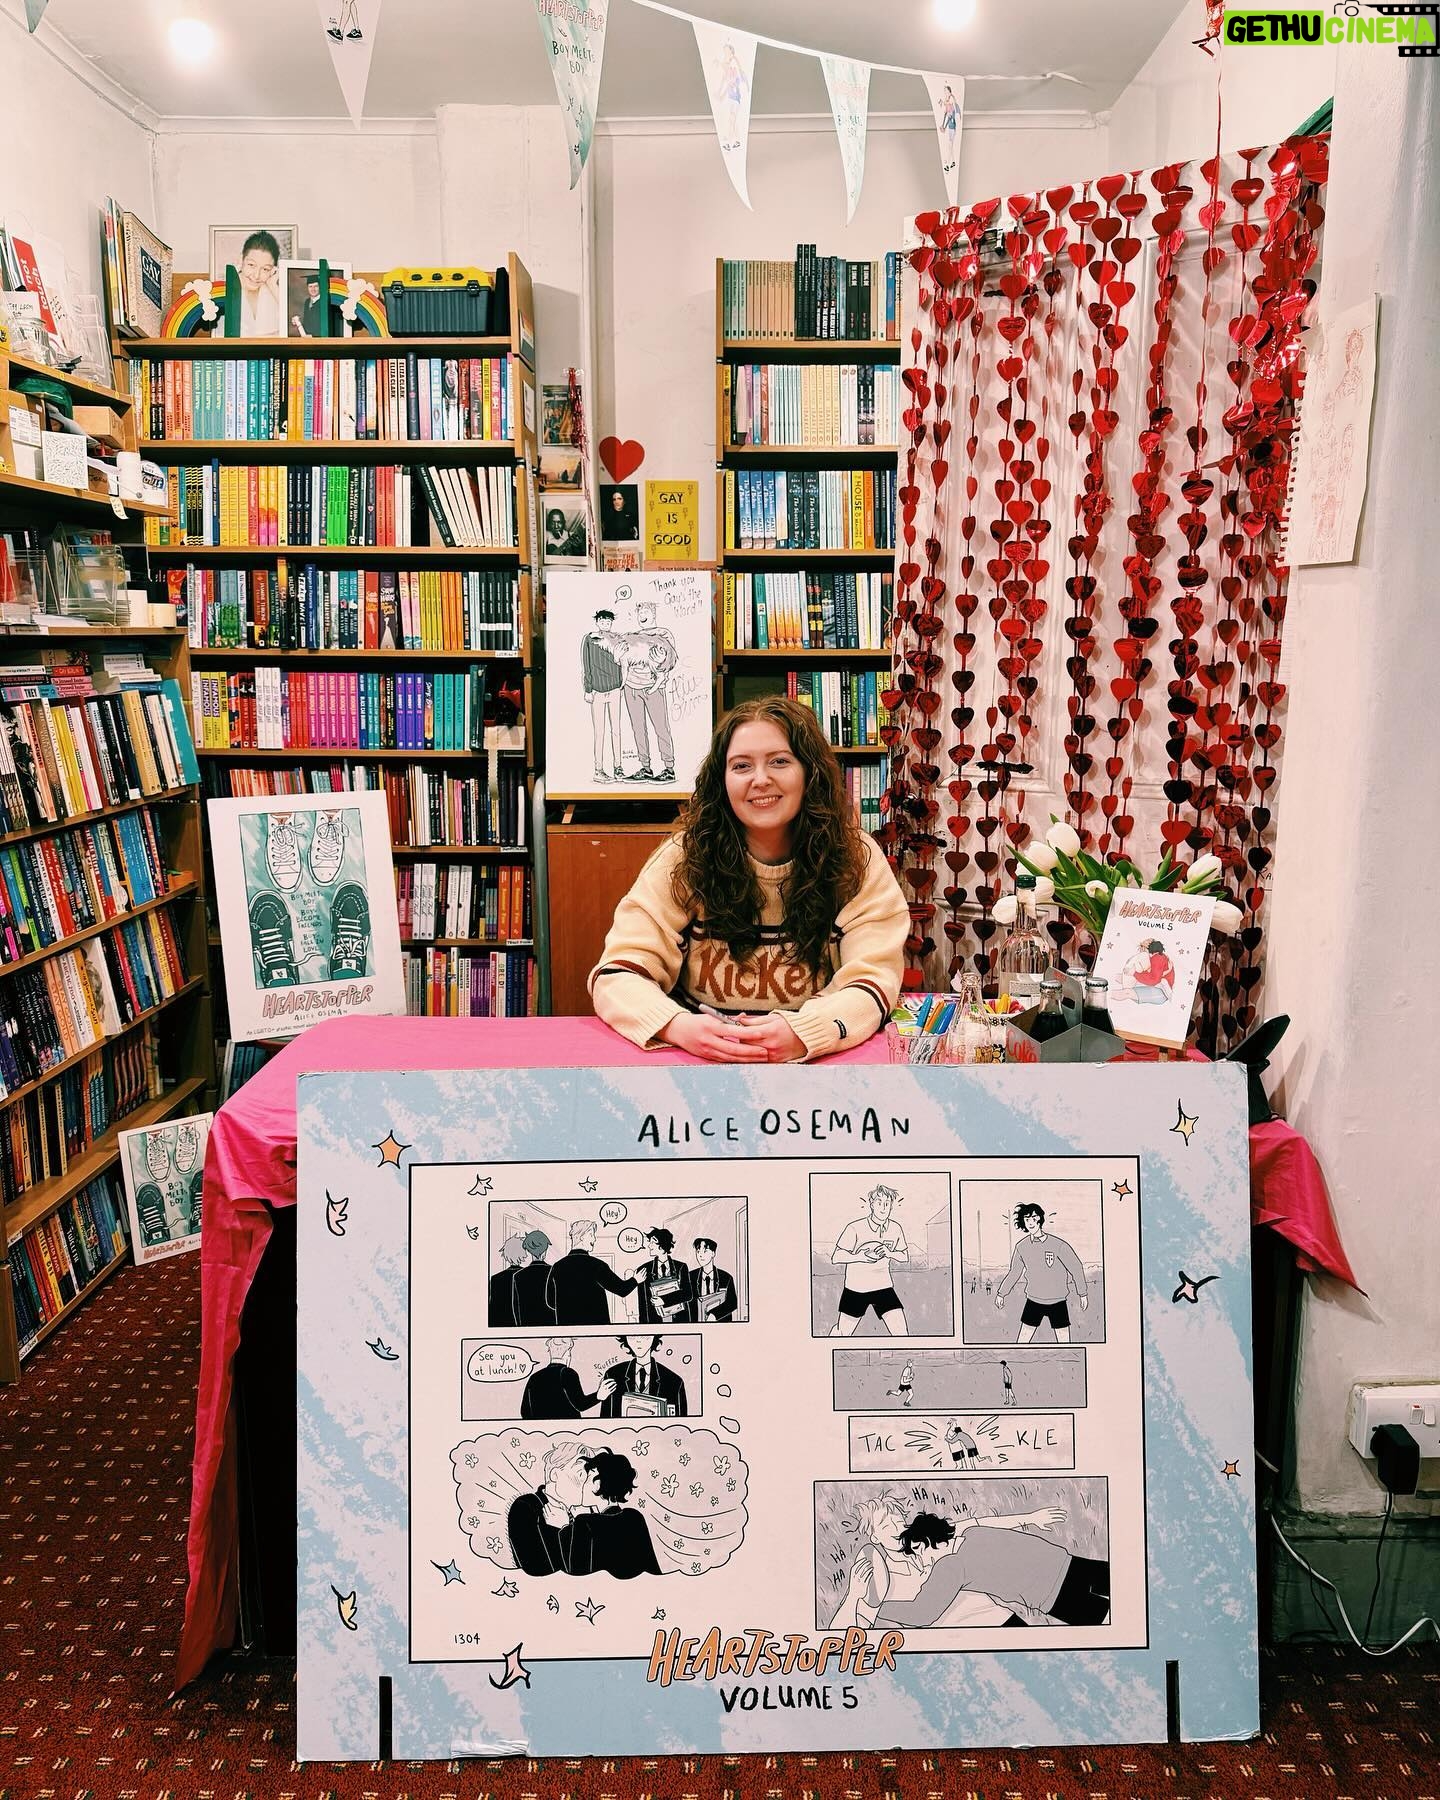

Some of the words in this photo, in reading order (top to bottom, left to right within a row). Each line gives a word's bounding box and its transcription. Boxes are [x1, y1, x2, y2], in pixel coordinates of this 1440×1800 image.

[552, 41, 570, 59] BOY
[659, 493, 684, 504] GAY
[854, 480, 862, 511] HOUSE
[667, 512, 678, 524] IS
[653, 534, 692, 545] GOOD
[793, 530, 801, 542] Boy
[649, 578, 677, 592] Thank
[726, 574, 734, 595] Swan
[726, 596, 734, 615] Song
[202, 680, 211, 717] INFAMOUS
[212, 680, 220, 717] INFAMOUS
[26, 714, 38, 743] Morris
[34, 743, 44, 767] Kight
[1118, 900, 1203, 925] HEARTSTOPPER
[1138, 920, 1165, 930] VOLUME
[1167, 922, 1174, 931] 5
[262, 984, 374, 1019] HEARTSTOPPER
[317, 1008, 348, 1017] OSEMAN
[637, 1114, 739, 1148] ALICE
[760, 1108, 910, 1143] OSEMAN
[605, 1207, 621, 1219] Hey!
[625, 1235, 638, 1244] Hey
[478, 1351, 494, 1361] See
[500, 1354, 516, 1368] you
[593, 1355, 619, 1371] SQUEEZE
[474, 1368, 485, 1377] at
[488, 1363, 517, 1375] lunch!
[858, 1432, 896, 1454] TAC
[1016, 1428, 1058, 1450] KLE
[912, 1487, 929, 1501] HA
[932, 1492, 946, 1506] HA
[952, 1502, 969, 1515] HA
[829, 1548, 847, 1565] HA
[832, 1568, 847, 1587] HA
[453, 1632, 482, 1646] 1304
[646, 1626, 905, 1688] HEARTSTOPPER
[719, 1686, 833, 1713] VOLUME
[842, 1685, 859, 1710] 5
